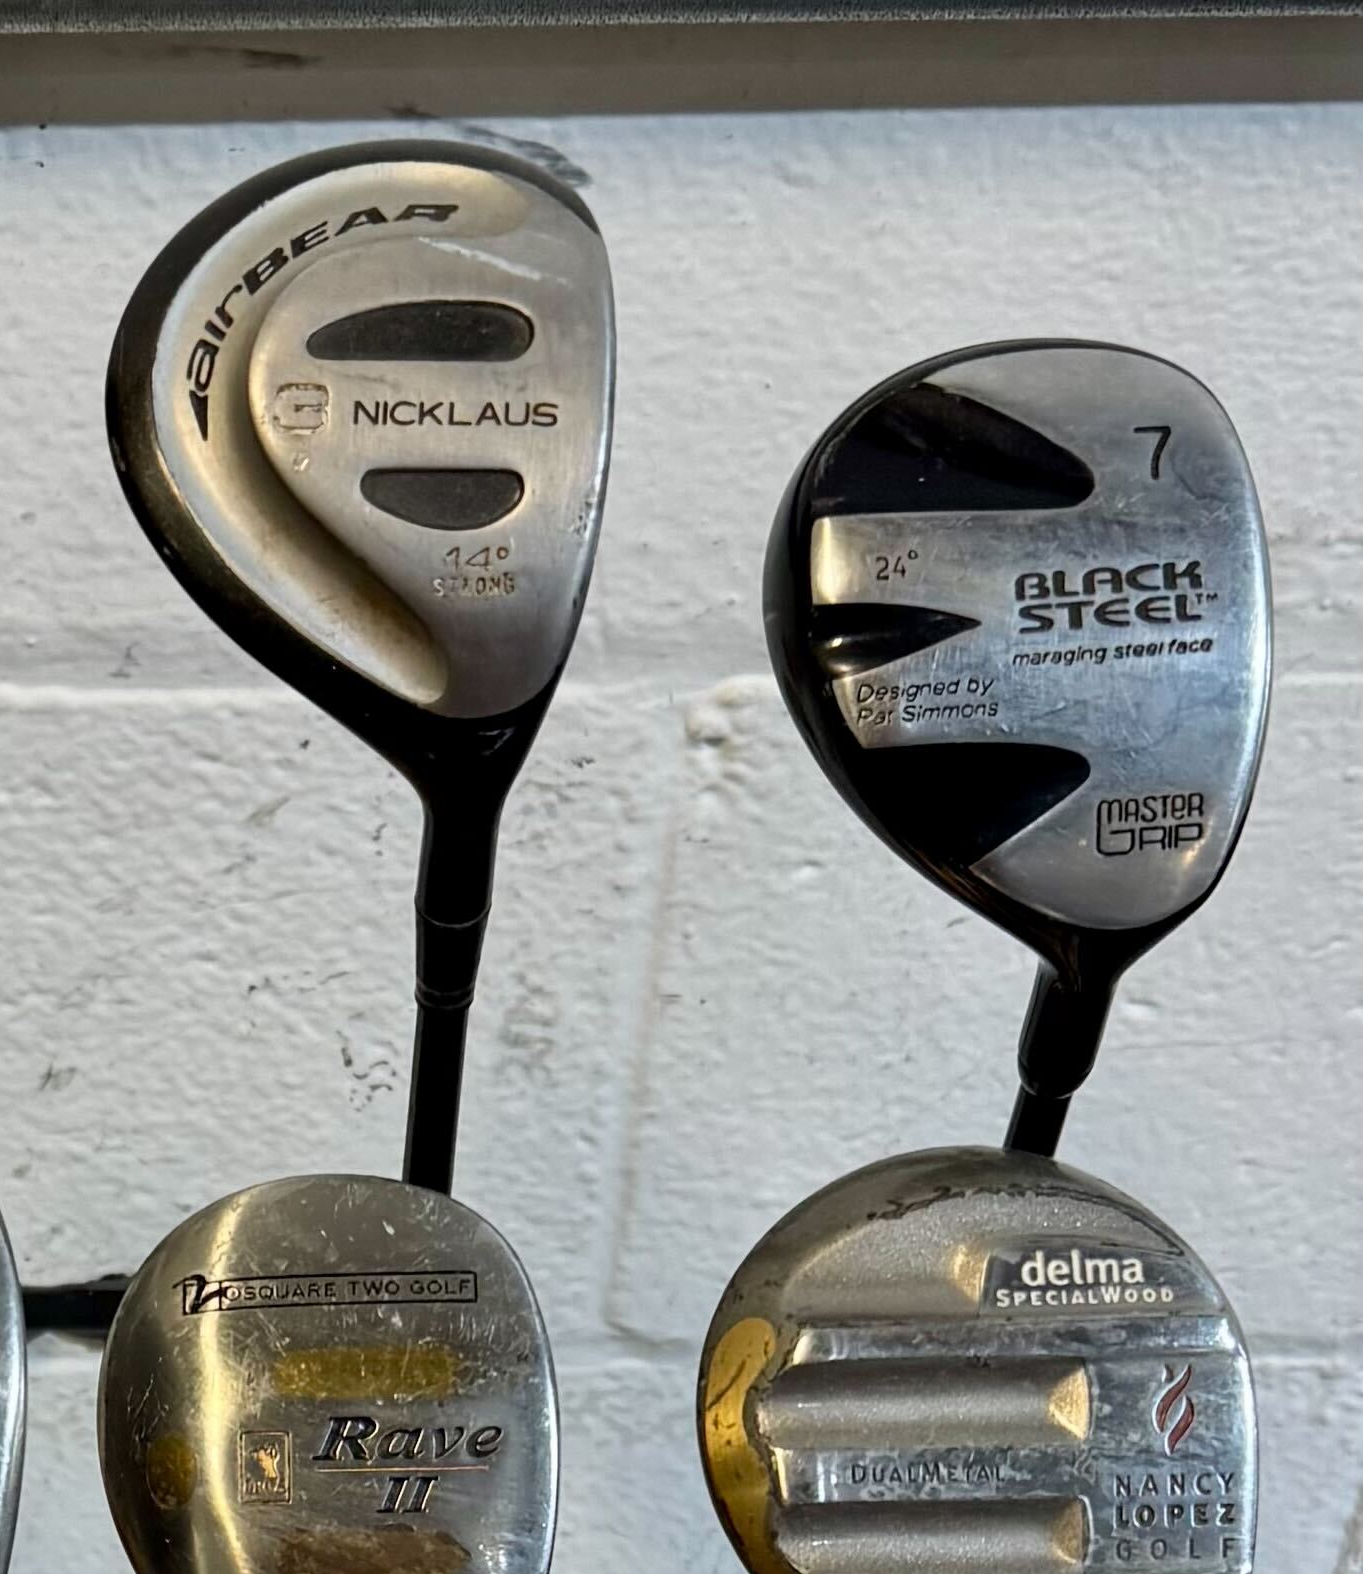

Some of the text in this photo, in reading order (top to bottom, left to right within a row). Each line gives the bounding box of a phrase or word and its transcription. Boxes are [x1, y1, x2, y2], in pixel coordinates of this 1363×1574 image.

[353, 400, 559, 427] NICKLAUS
[1133, 425, 1172, 481] 7
[443, 546, 509, 573] 14°
[875, 549, 918, 582] 24°
[1014, 560, 1203, 601] BLACK
[1012, 637, 1214, 666] maraging steel face
[857, 677, 995, 703] Designed by
[901, 702, 999, 723] Simmons
[1096, 823, 1203, 856] GRIP
[1020, 1249, 1146, 1289] delma
[242, 1281, 337, 1300] SQUARE
[348, 1279, 399, 1297] TWO
[409, 1278, 471, 1295] GOLF
[311, 1416, 504, 1462] Rave
[376, 1476, 438, 1514] II
[1113, 1473, 1236, 1497] NANCY
[1112, 1502, 1236, 1528] LOPEZ
[1114, 1538, 1238, 1562] GOLF
